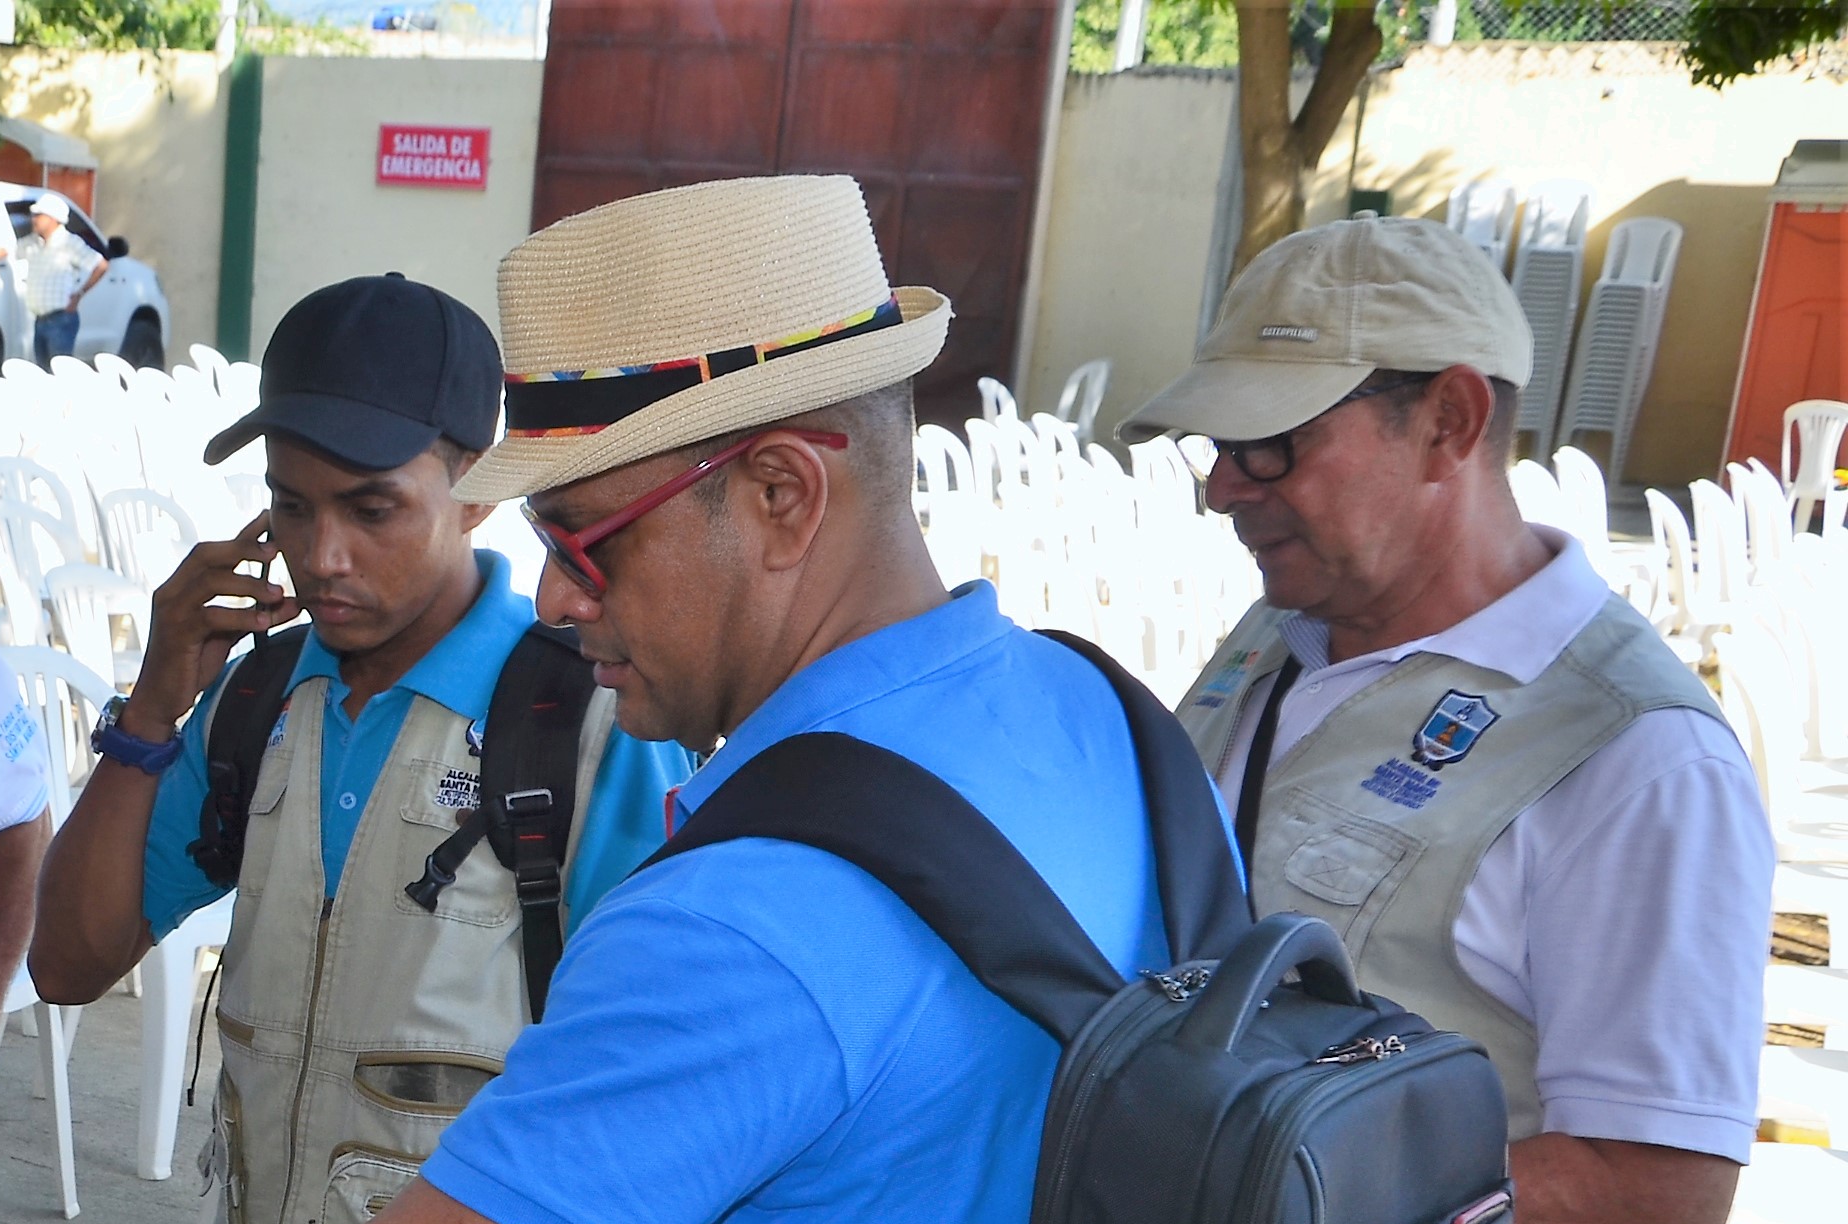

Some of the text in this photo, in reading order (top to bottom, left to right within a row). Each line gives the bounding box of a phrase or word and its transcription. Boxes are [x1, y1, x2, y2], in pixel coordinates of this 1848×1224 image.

[394, 133, 472, 156] SALIDA DE
[382, 155, 482, 179] EMERGENCIA
